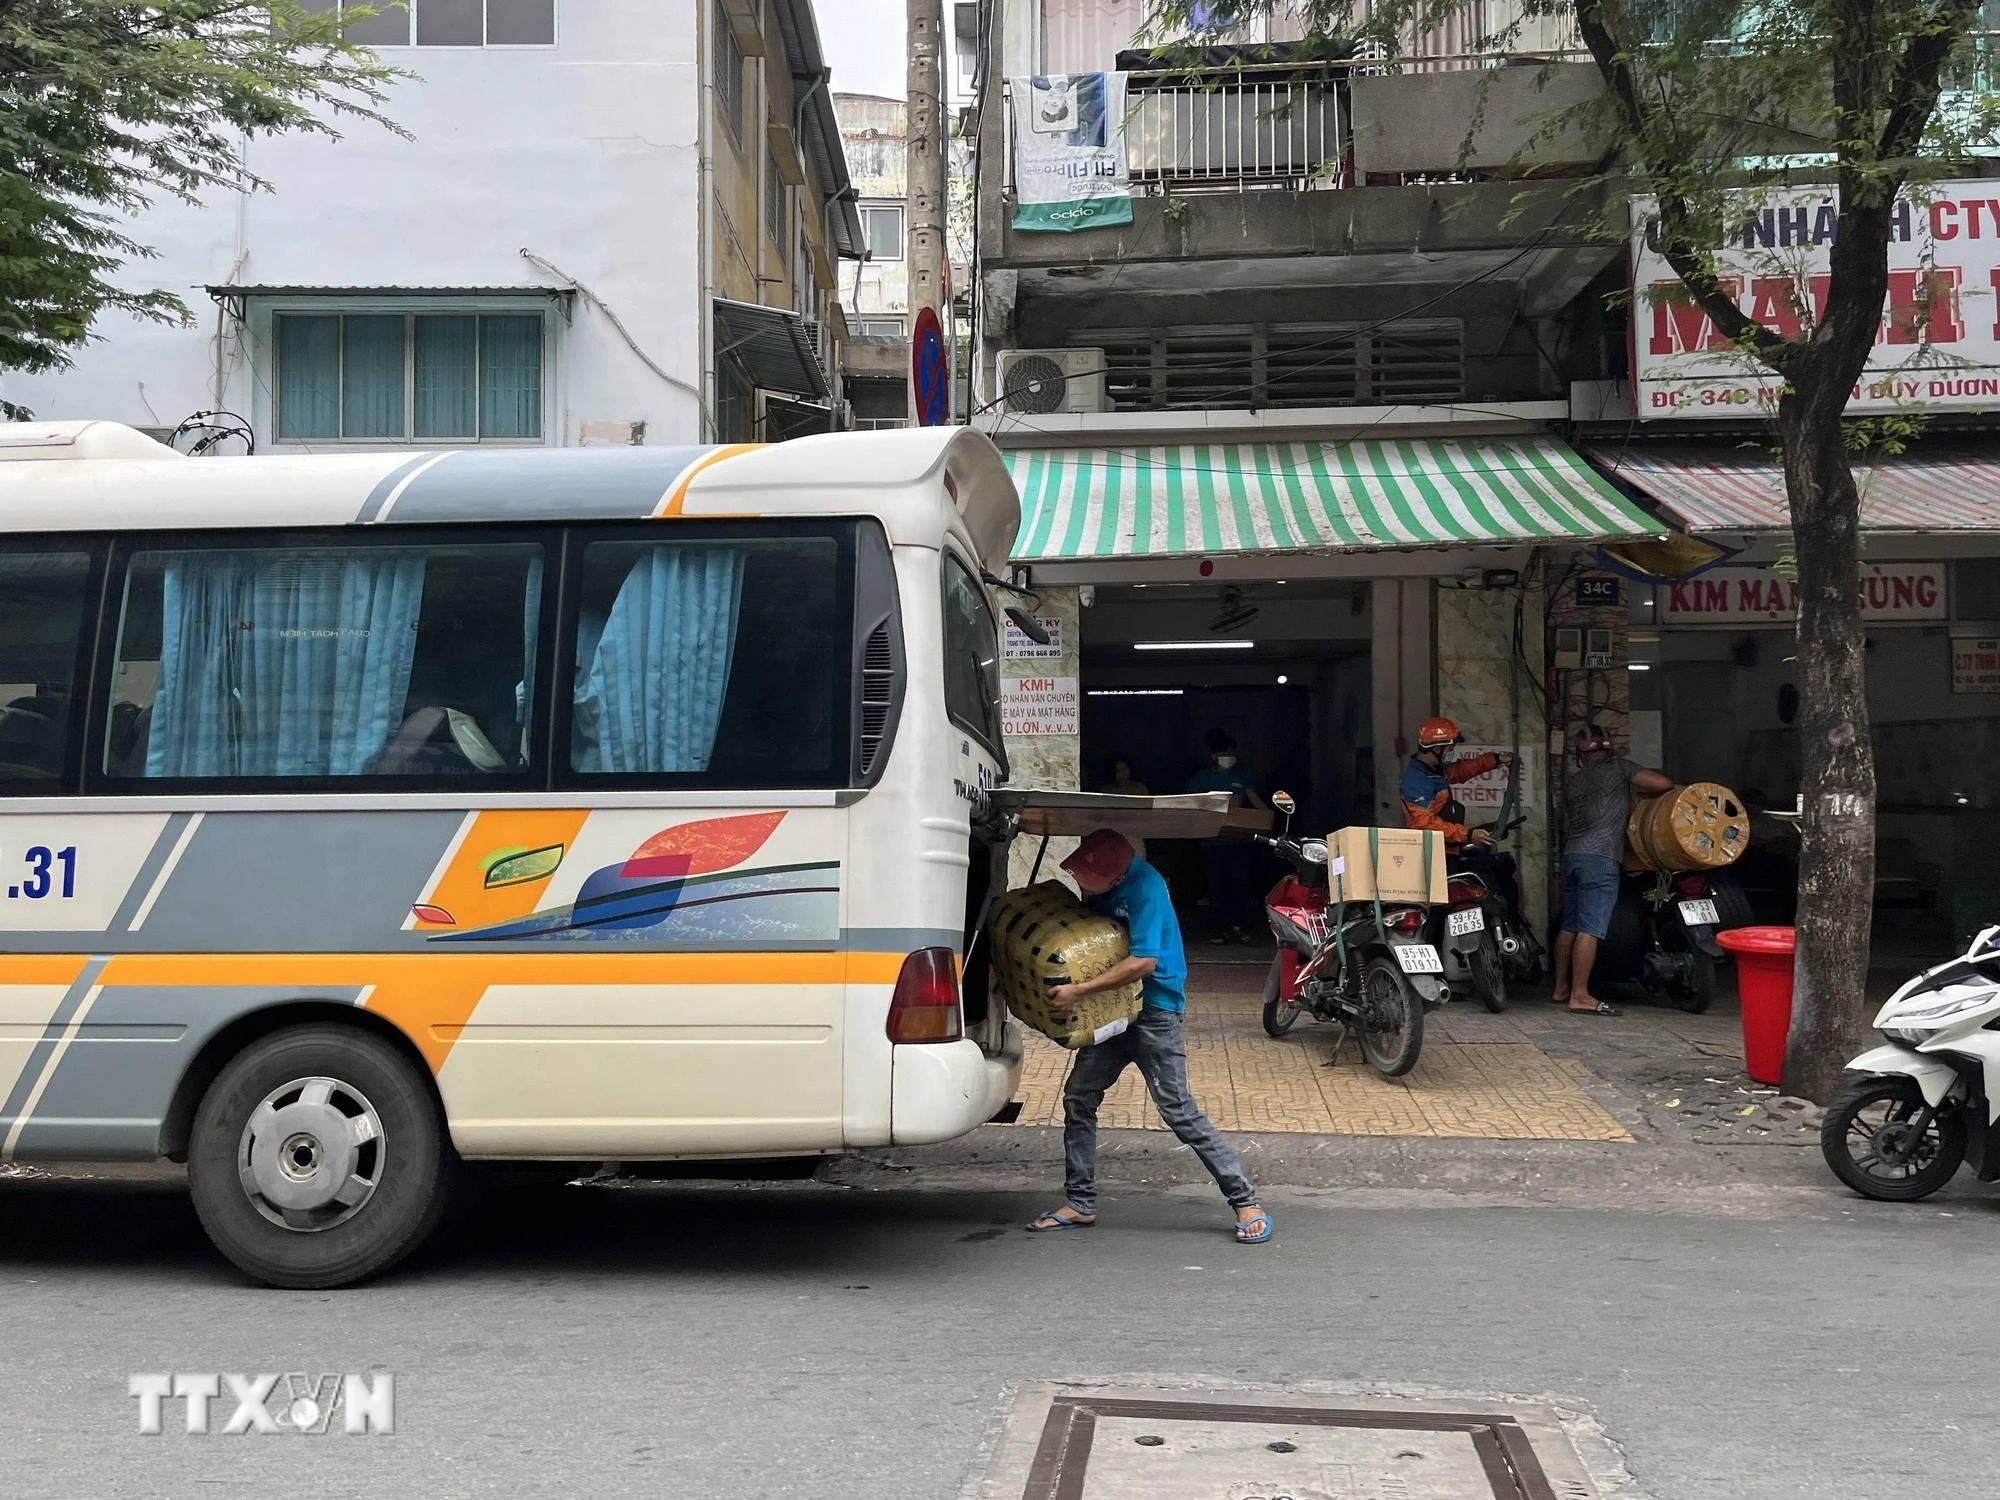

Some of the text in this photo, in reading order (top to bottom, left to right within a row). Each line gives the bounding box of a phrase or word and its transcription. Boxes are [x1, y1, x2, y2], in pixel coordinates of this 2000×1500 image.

[1744, 197, 1912, 250] NHÁH
[1582, 581, 1612, 595] 34C
[1668, 579, 1728, 613] KIM
[1858, 566, 1937, 611] ÙNG
[1020, 679, 1055, 691] KMH
